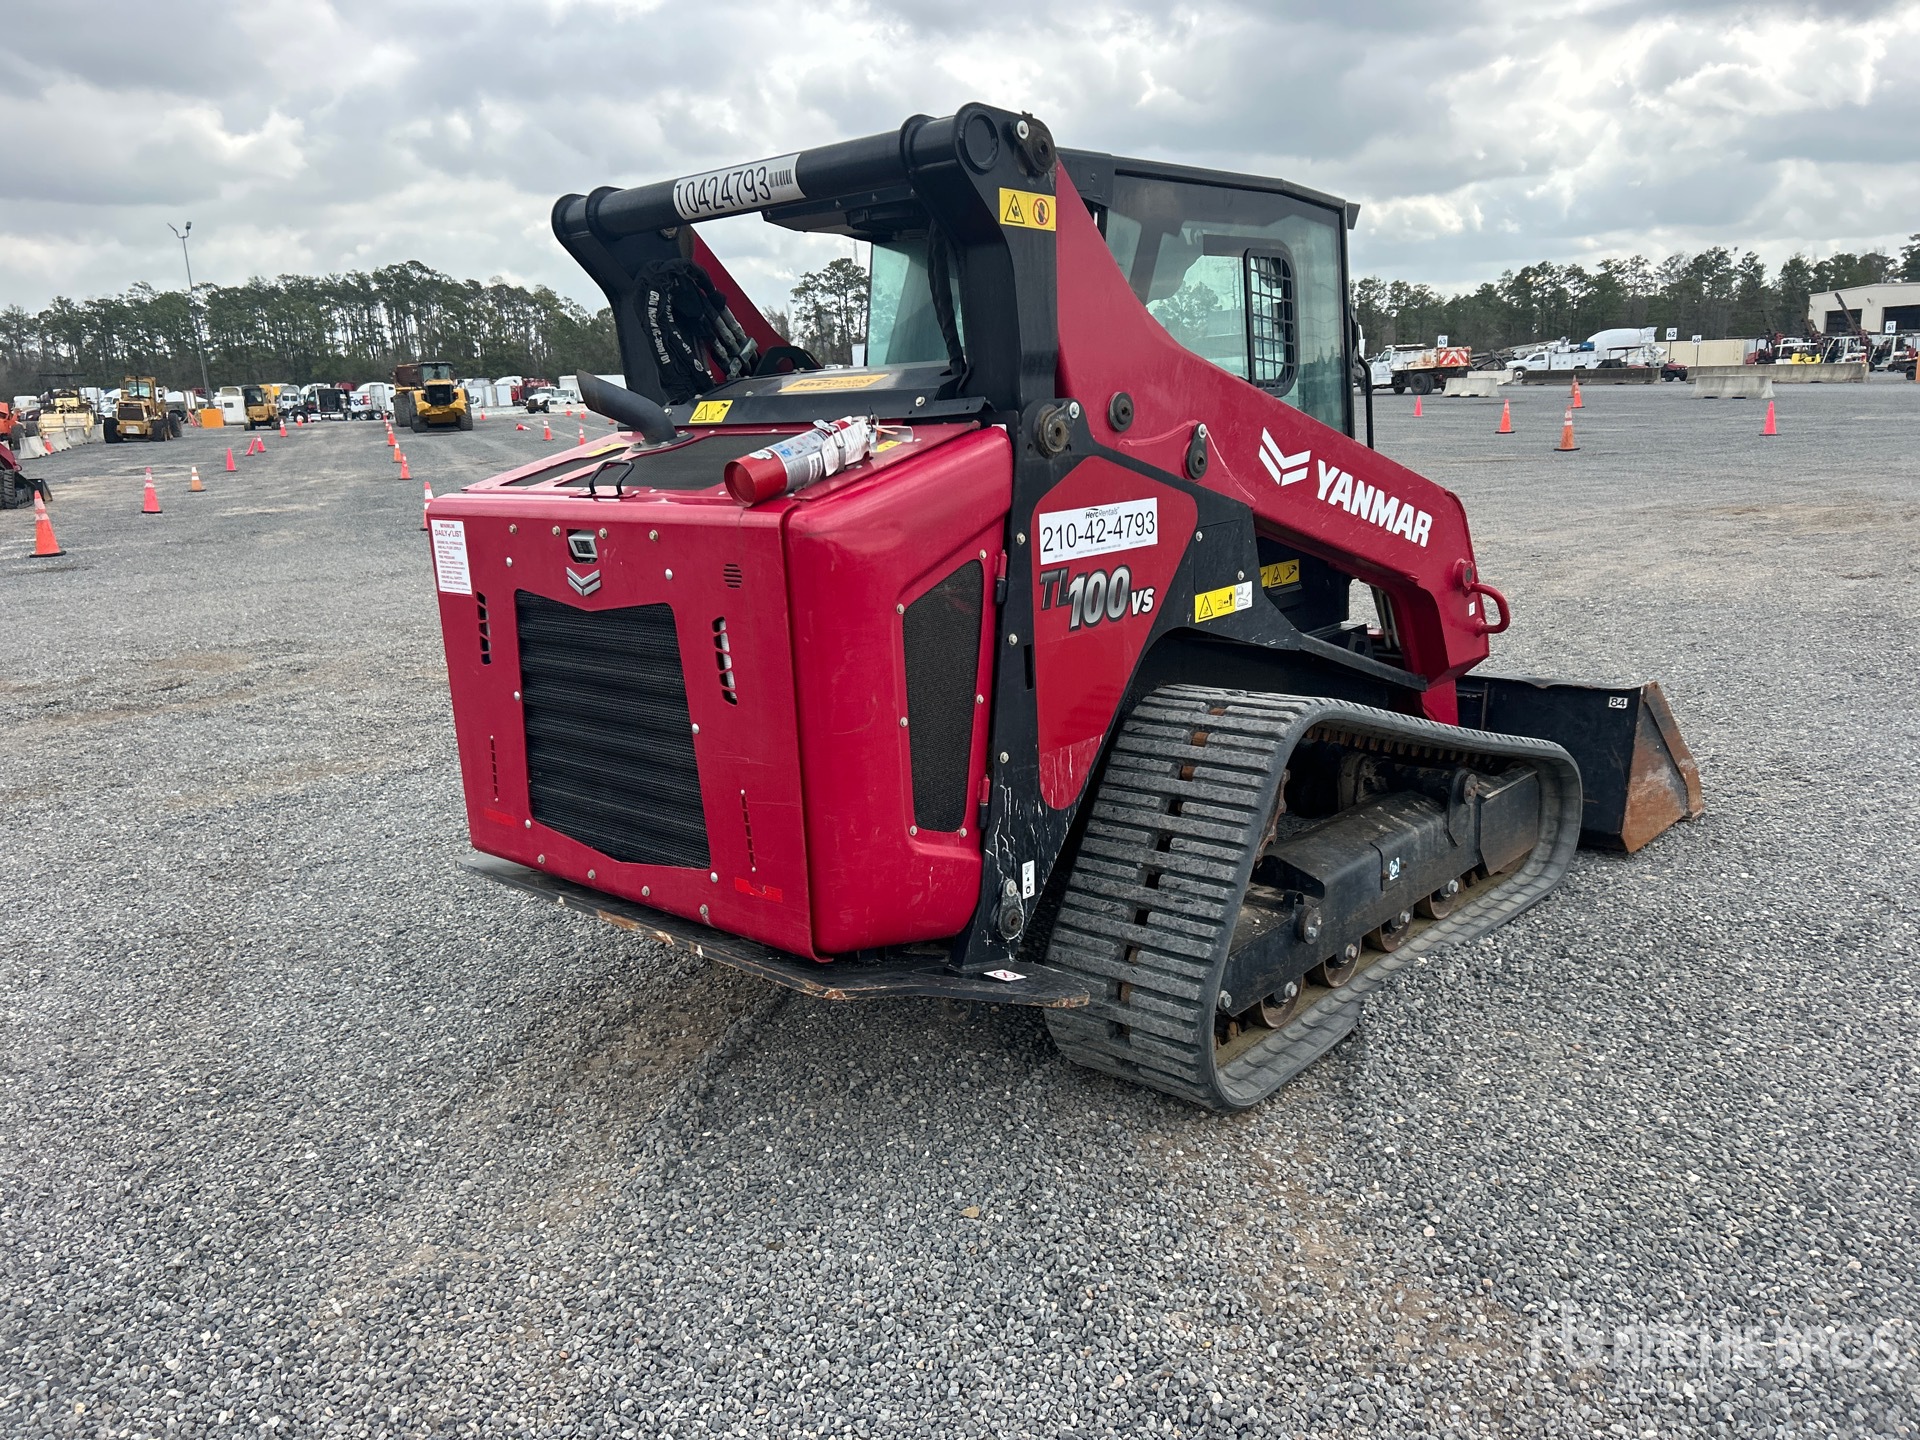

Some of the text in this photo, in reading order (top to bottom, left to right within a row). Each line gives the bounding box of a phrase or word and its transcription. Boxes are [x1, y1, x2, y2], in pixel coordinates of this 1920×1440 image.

[676, 166, 771, 216] 10424793
[1316, 459, 1433, 548] YANMAR
[1042, 511, 1155, 553] 210-42-4793
[1610, 697, 1626, 708] 84
